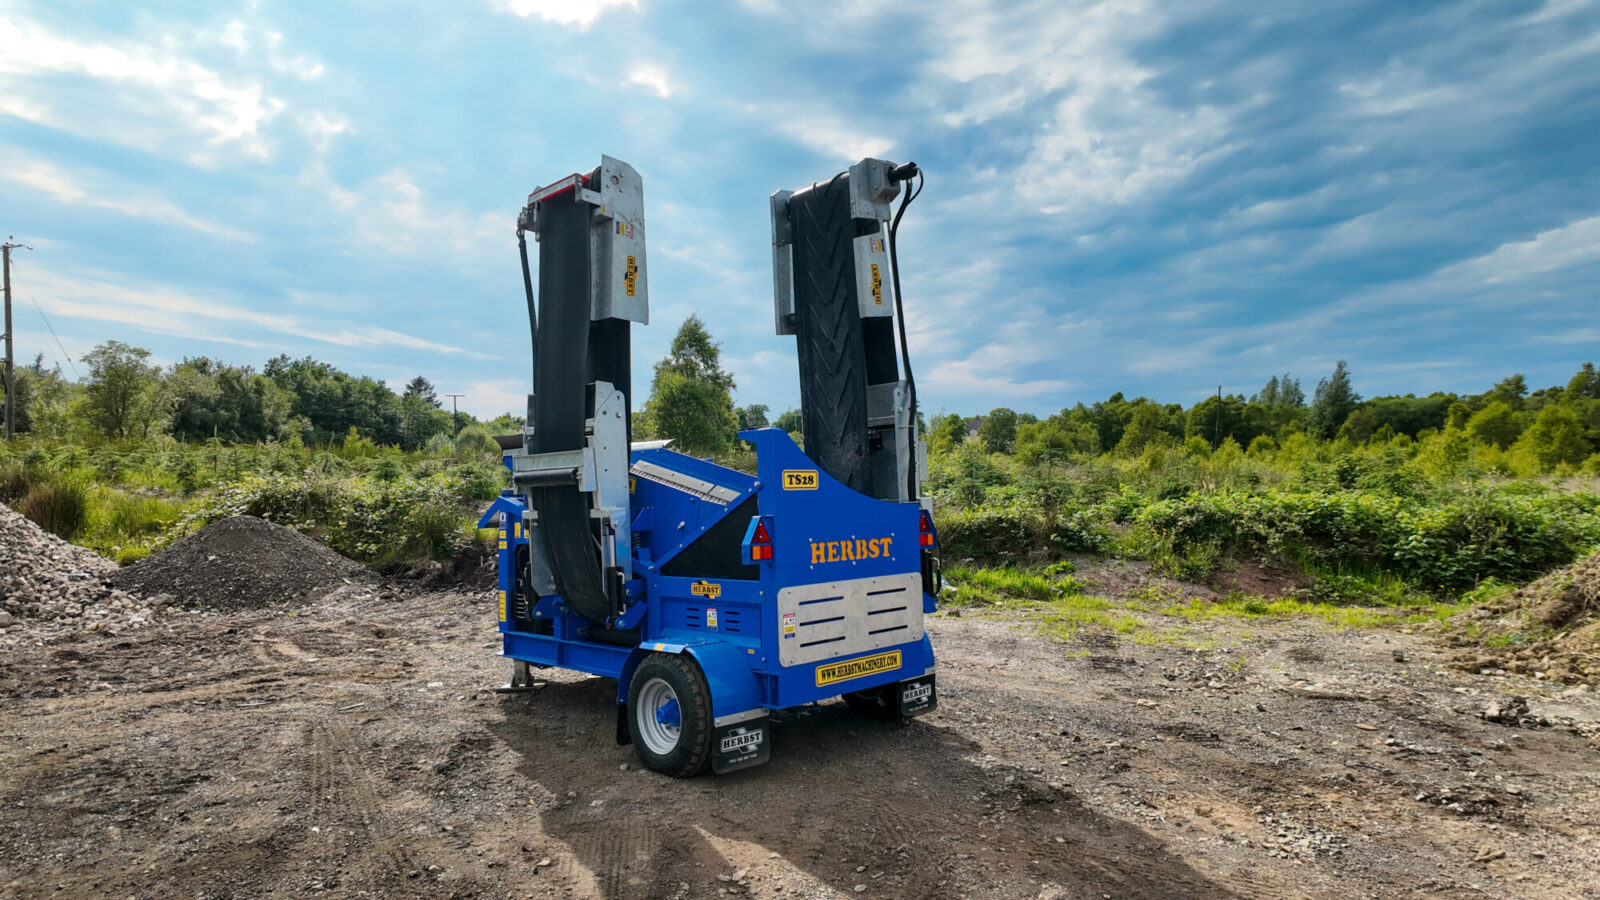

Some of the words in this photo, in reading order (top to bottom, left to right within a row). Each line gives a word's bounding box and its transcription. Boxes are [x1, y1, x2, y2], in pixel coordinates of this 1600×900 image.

[787, 474, 814, 485] TS28
[810, 537, 892, 564] HERBST
[693, 586, 719, 594] HERBST
[821, 654, 898, 680] WWW.HERBSTMACHINERY.COM
[904, 685, 930, 700] HERBST
[723, 732, 761, 749] HERBST
